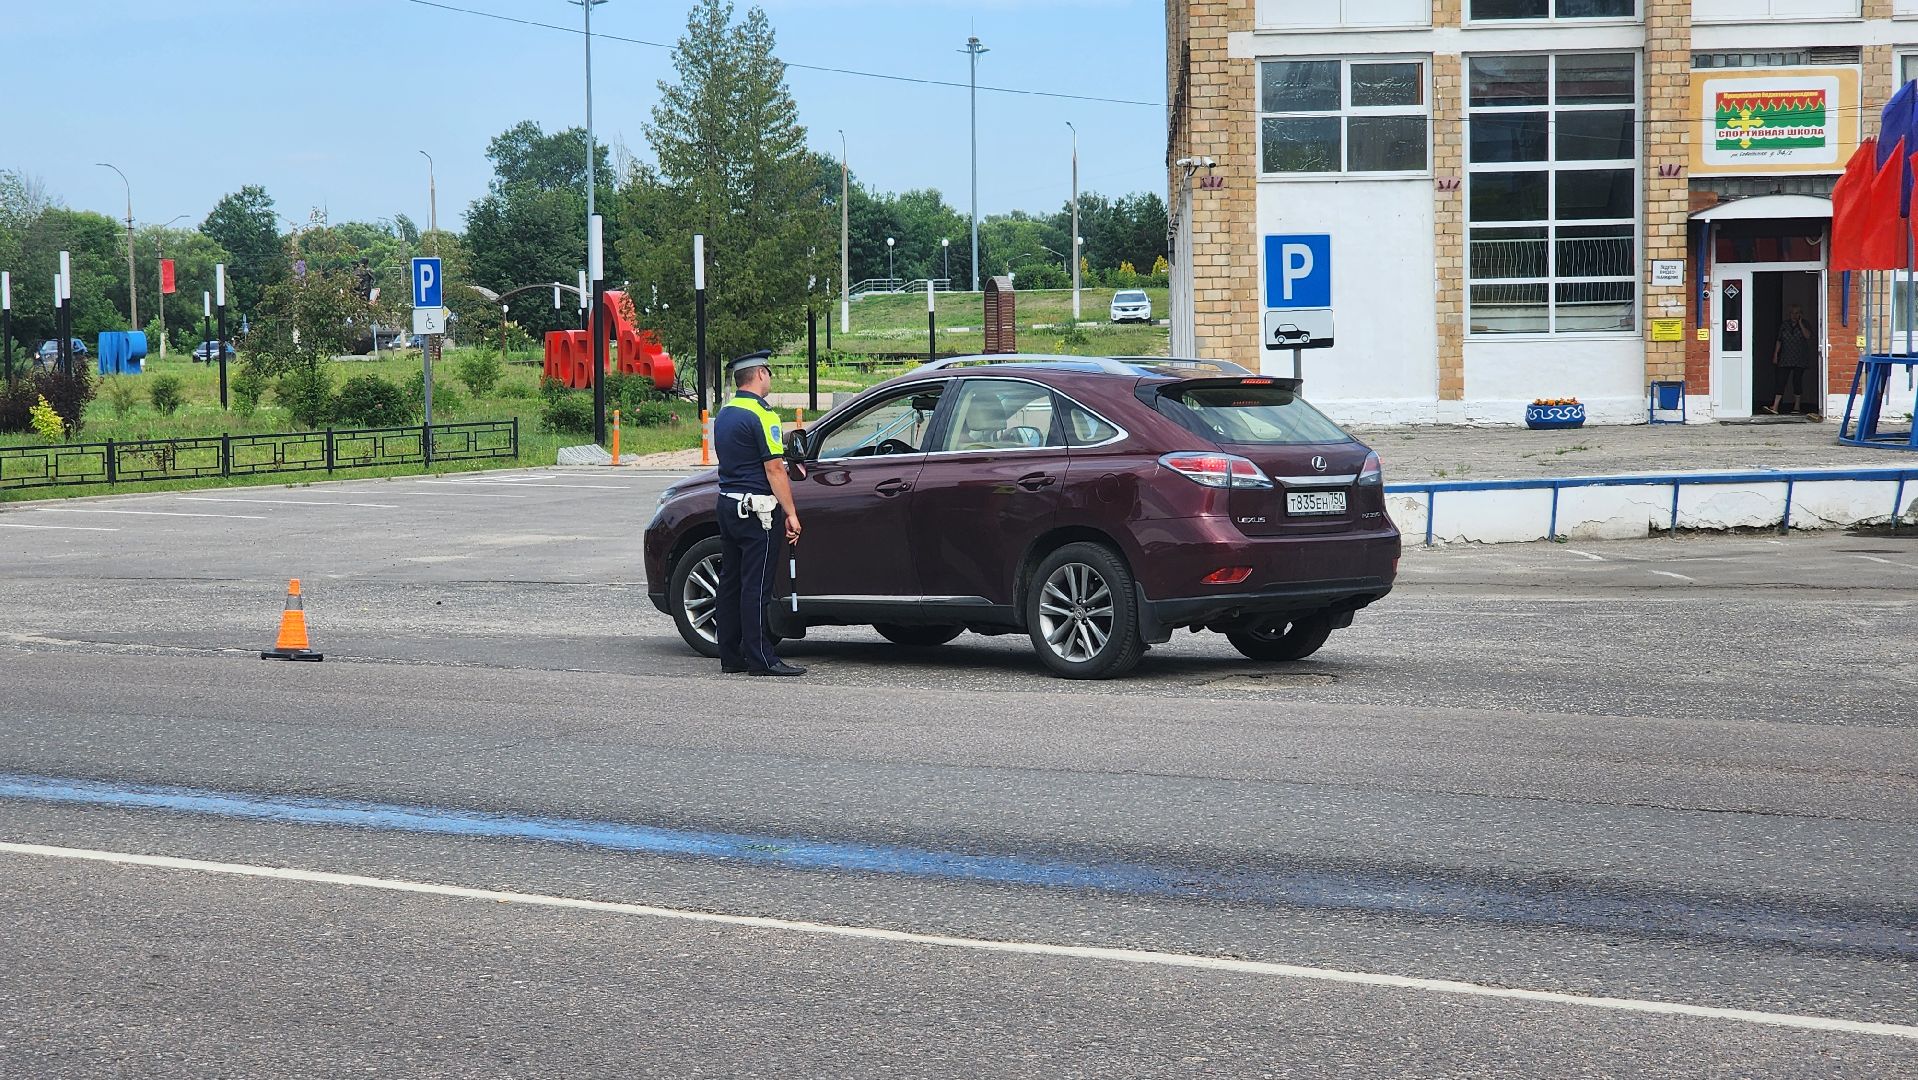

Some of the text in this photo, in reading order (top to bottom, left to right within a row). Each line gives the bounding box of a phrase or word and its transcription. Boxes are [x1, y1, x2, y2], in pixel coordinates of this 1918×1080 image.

[1718, 128, 1825, 138] СПОРТИВНАЯ ШКОЛА
[420, 264, 434, 302] P
[1282, 243, 1314, 300] P
